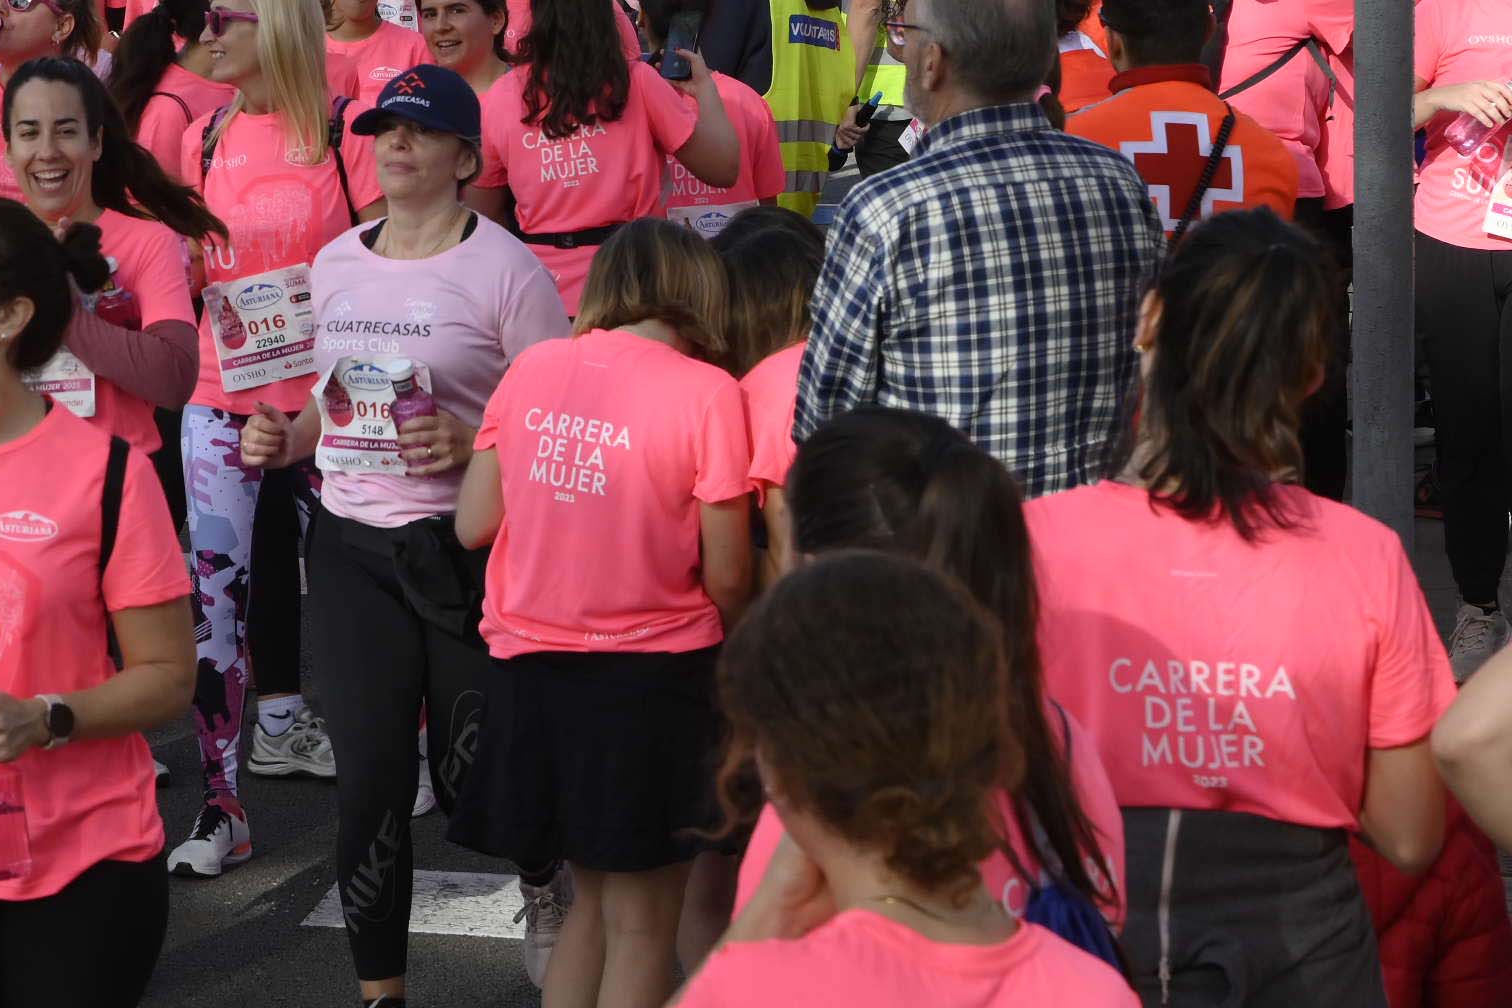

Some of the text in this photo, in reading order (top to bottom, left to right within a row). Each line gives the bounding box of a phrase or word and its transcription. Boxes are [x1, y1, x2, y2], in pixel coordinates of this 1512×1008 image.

[541, 139, 593, 164] DE LA
[540, 157, 600, 184] MUJER
[239, 292, 281, 307] ASTURIANA
[248, 314, 286, 335] 016
[327, 320, 431, 338] CUATRECASAS
[255, 334, 286, 349] 22940
[321, 336, 400, 355] Sports Club
[233, 367, 266, 383] OYSHO
[357, 400, 391, 420] 016
[361, 424, 384, 436] 5148
[524, 407, 631, 450] CARRERA
[361, 440, 369, 448] DE
[370, 440, 379, 449] LA
[537, 434, 605, 470] DE LA
[529, 457, 606, 496] MUJER
[554, 491, 576, 503] 2023
[1108, 657, 1297, 701] CARRERA
[1144, 696, 1257, 733] DE LA
[1141, 732, 1266, 770] MUJER
[1193, 773, 1228, 789] 2023
